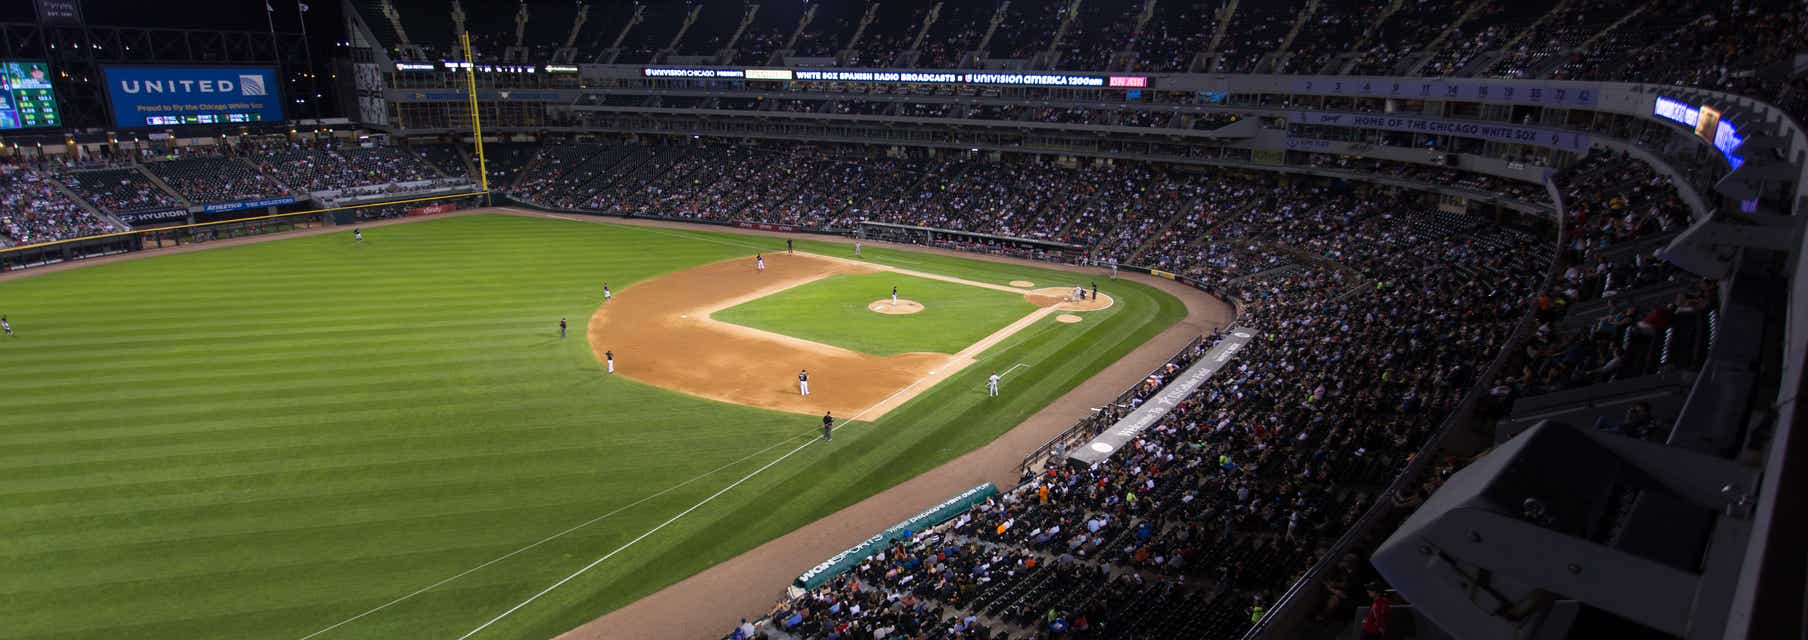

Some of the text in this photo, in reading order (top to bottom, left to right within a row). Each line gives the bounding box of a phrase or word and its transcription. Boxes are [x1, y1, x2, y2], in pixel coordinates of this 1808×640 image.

[796, 71, 821, 80] WHITE
[822, 72, 838, 80] SOX
[839, 72, 873, 81] SPANISH
[874, 72, 899, 81] RADIO
[900, 73, 956, 82] BROADCASTS
[973, 74, 1023, 83] UNIVISION
[121, 80, 235, 94] UNITED
[137, 104, 161, 112] Proud
[1353, 115, 1385, 126] HOME
[1388, 118, 1404, 128] OF
[1408, 119, 1427, 130] THE
[1430, 121, 1478, 134] CHICAGO
[1481, 126, 1513, 138] WHITE
[1515, 129, 1537, 142] SOX
[138, 210, 188, 220] HYUNDAI
